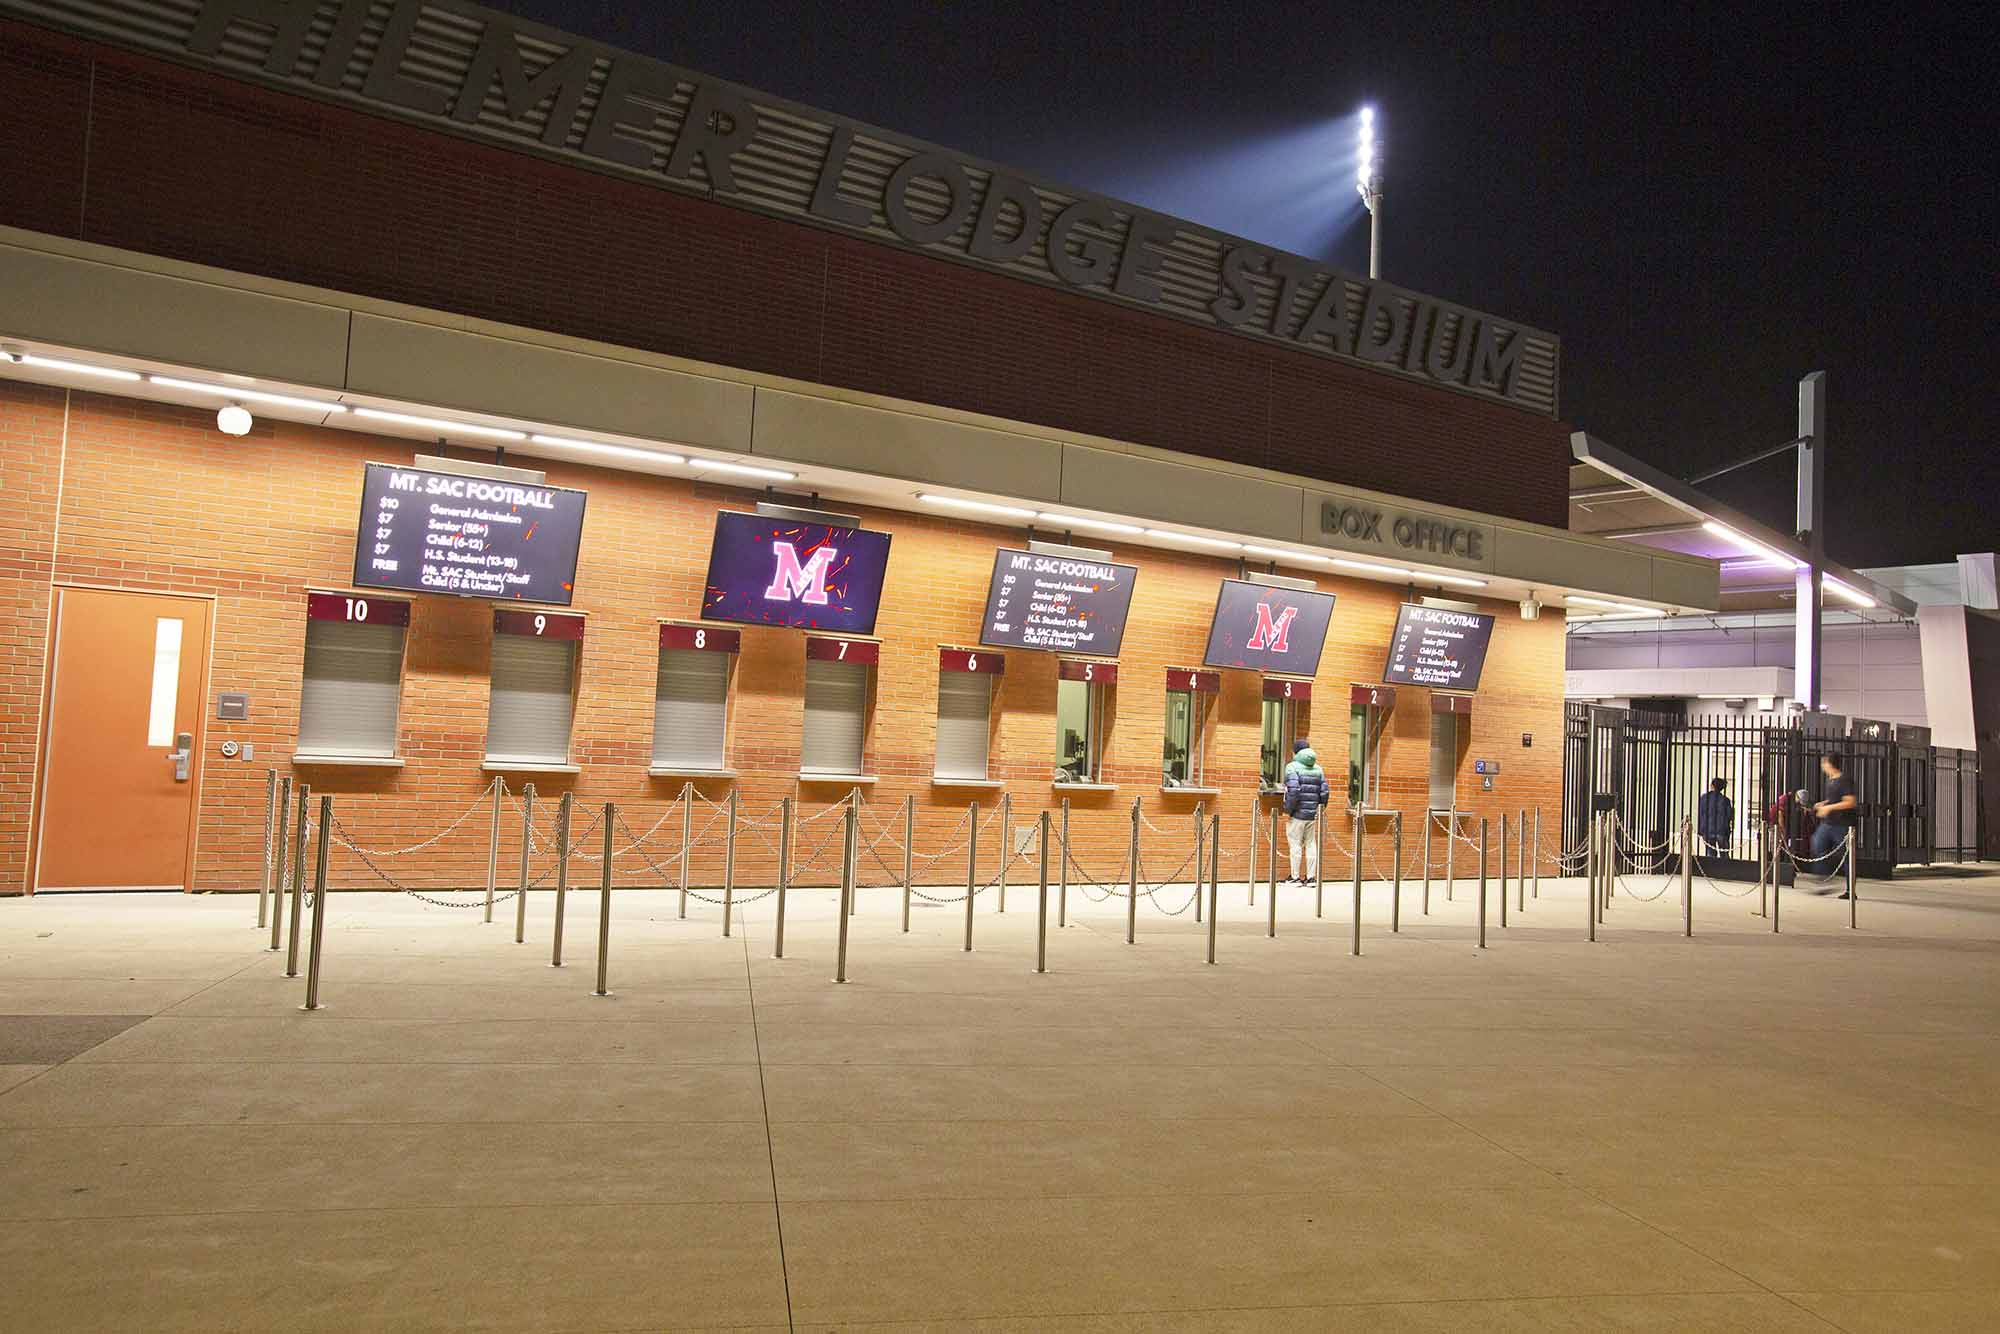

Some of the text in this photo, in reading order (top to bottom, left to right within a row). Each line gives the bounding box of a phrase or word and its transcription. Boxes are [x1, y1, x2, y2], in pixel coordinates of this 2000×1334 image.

[186, 0, 1528, 398] HILMER LODGE STADIUM
[389, 473, 554, 509] MT. SAC FOOTBALL
[380, 496, 399, 510] $10
[430, 504, 471, 519] General
[378, 512, 393, 525] $7
[428, 519, 461, 532] Senior
[1320, 502, 1483, 560] BOX OFFICE
[376, 528, 483, 551] $7 Child (6-12)
[374, 544, 390, 556] $7
[424, 550, 444, 561] H.S.
[447, 552, 485, 565] Student
[373, 559, 398, 571] FREE
[422, 565, 440, 576] Mt.
[441, 567, 463, 578] SAC
[764, 542, 838, 605] M
[1011, 556, 1115, 581] MT. SAC FOOTBALL
[421, 576, 447, 587] Child
[1035, 579, 1061, 589] General
[1032, 591, 1053, 600] Senior
[346, 599, 368, 622] 10
[1030, 603, 1047, 612] Child
[534, 615, 546, 634] 9
[1247, 603, 1298, 652] M
[1409, 610, 1480, 628] MT. SAC FOOTBALL
[695, 630, 706, 648] 8
[1037, 628, 1052, 637] SAC
[838, 642, 848, 660] 7
[968, 654, 976, 671] 6
[1085, 664, 1092, 680] 5
[1190, 674, 1197, 688] 4
[1284, 683, 1292, 697] 3
[1371, 690, 1377, 704] 2
[1450, 697, 1454, 711] 1
